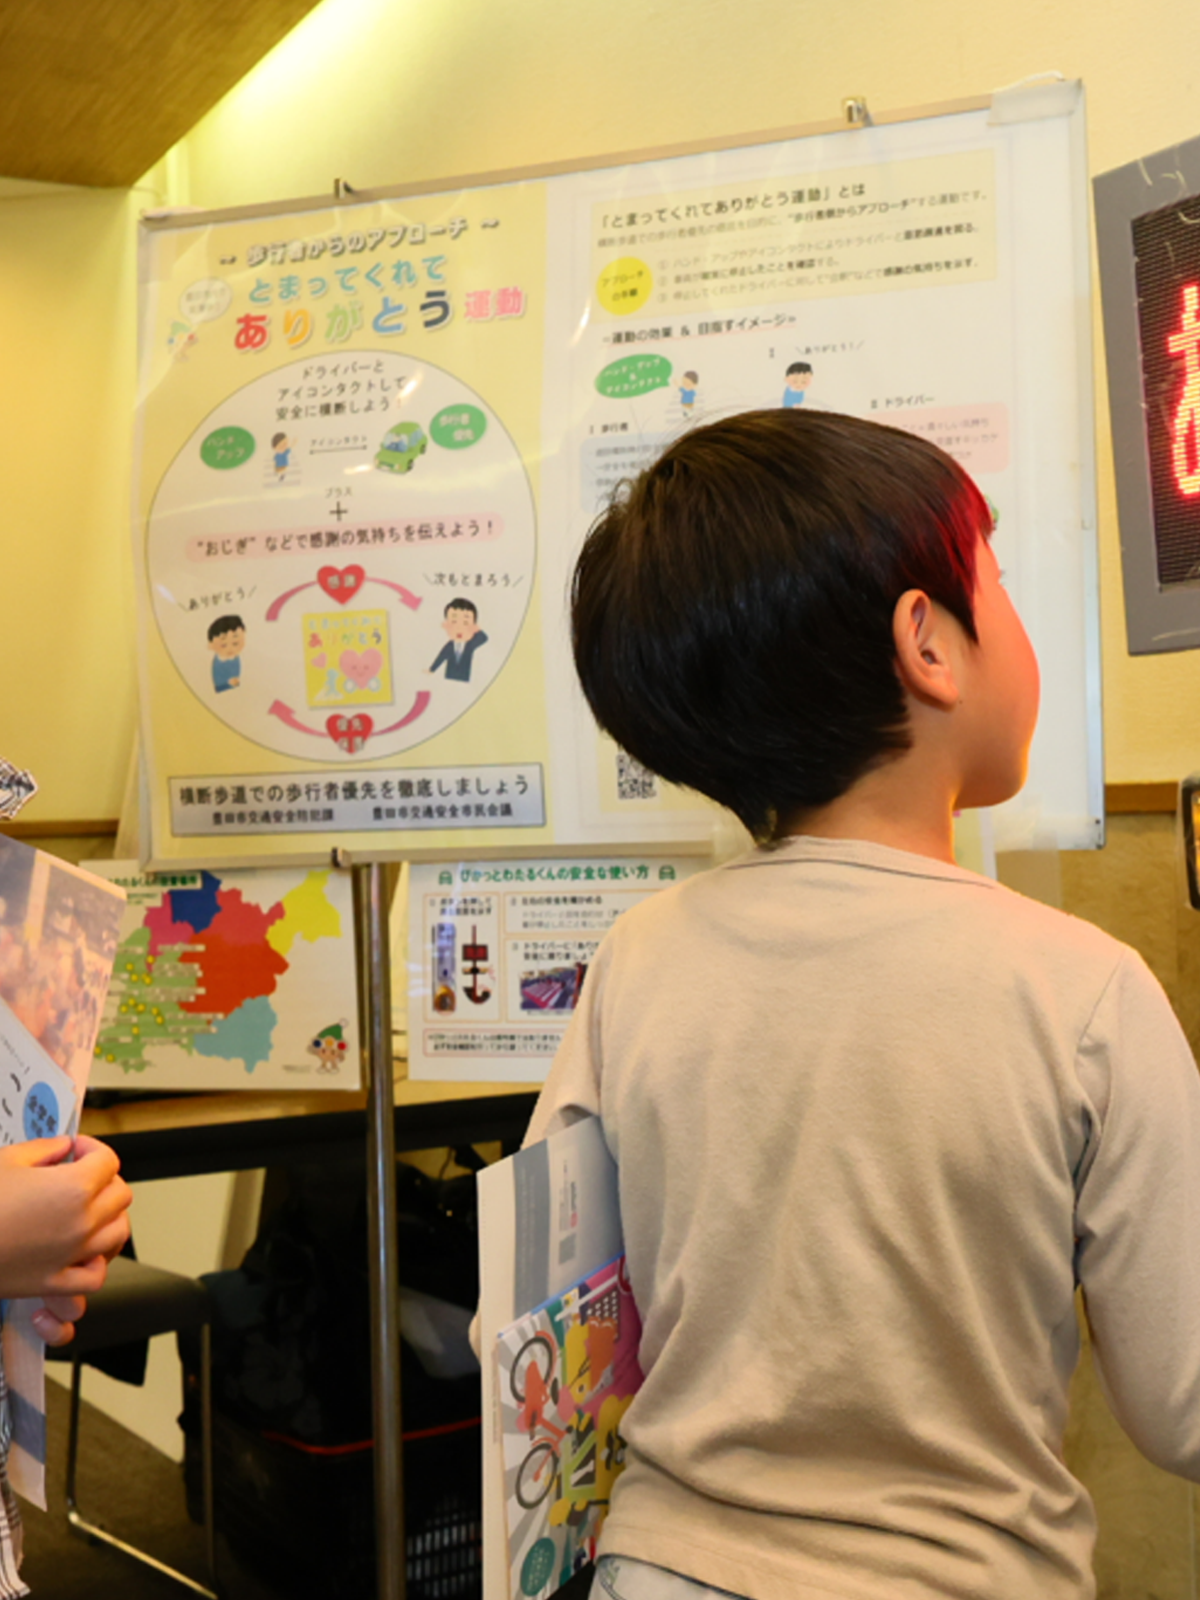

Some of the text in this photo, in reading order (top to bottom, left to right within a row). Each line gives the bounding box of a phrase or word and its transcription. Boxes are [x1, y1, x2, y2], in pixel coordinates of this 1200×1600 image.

[248, 254, 447, 304] とまってくれて
[302, 359, 385, 381] ドライバーと
[277, 376, 407, 402] アイコンタクトして
[433, 571, 513, 589] 次もとまろう
[188, 586, 247, 612] ありがとう
[179, 774, 530, 806] 横断歩道での歩行者優先を徹底しましょう
